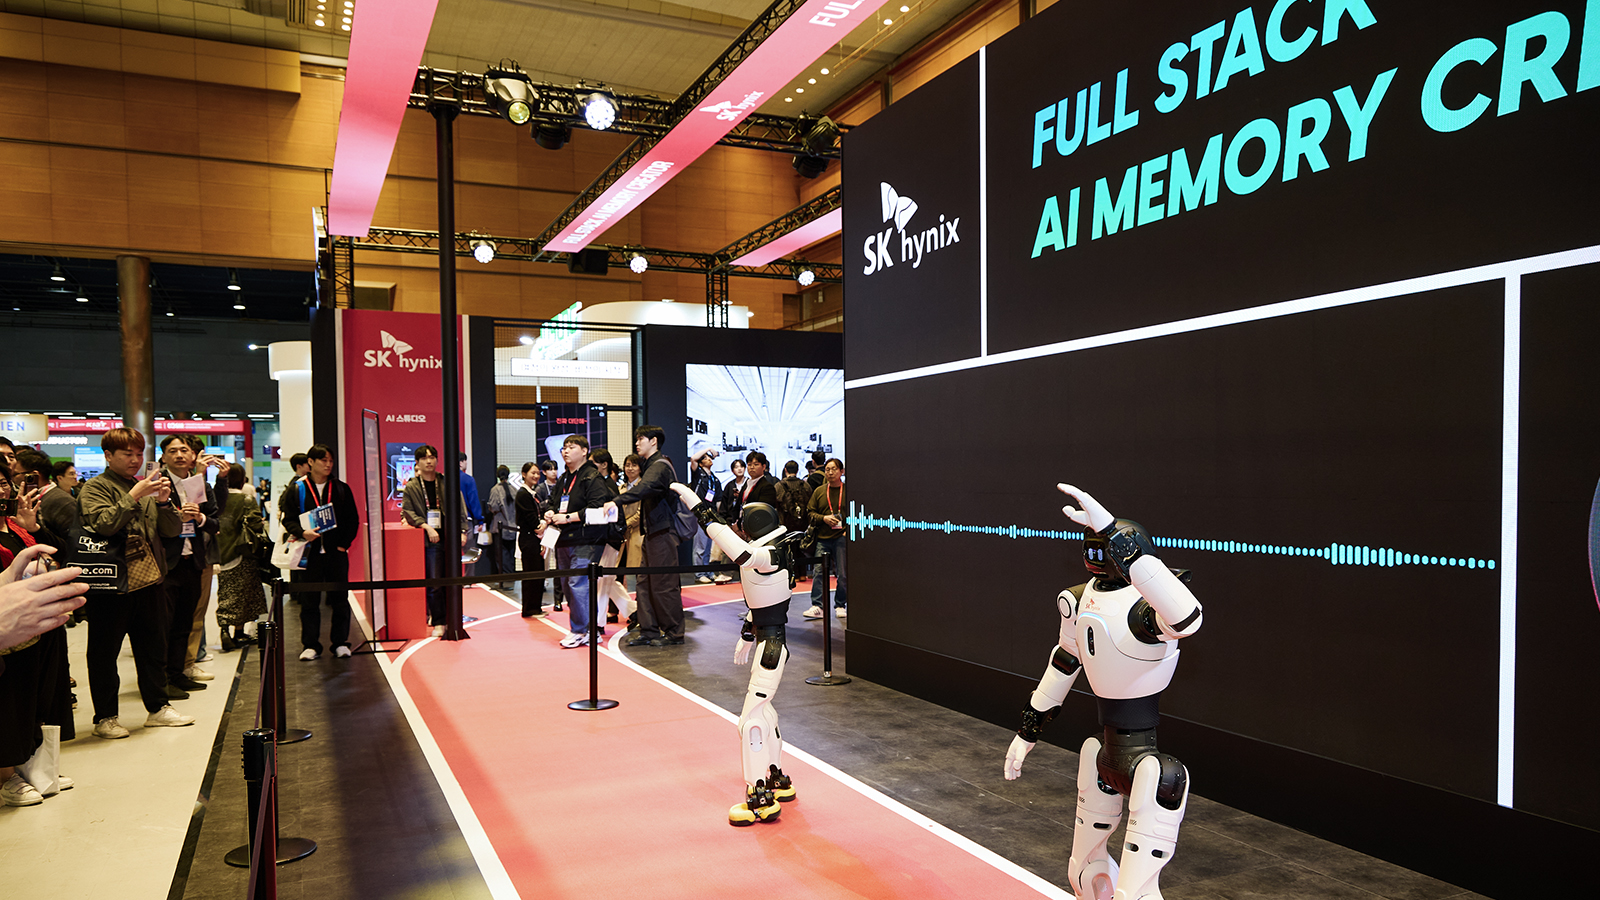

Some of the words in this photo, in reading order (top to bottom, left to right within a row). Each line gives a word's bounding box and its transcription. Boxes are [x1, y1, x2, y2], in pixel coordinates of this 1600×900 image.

[809, 0, 865, 27] FUL
[716, 109, 742, 121] SK
[731, 91, 764, 110] hynix
[1031, 67, 1140, 169] FULL
[625, 160, 675, 190] CREATOR
[1030, 186, 1081, 259] AI
[1091, 67, 1399, 241] MEMORY
[863, 226, 894, 275] SK
[901, 213, 960, 269] hynix
[363, 349, 393, 368] SK
[399, 353, 443, 373] hynix
[385, 414, 395, 422] AI
[396, 414, 427, 423] 스튜디오
